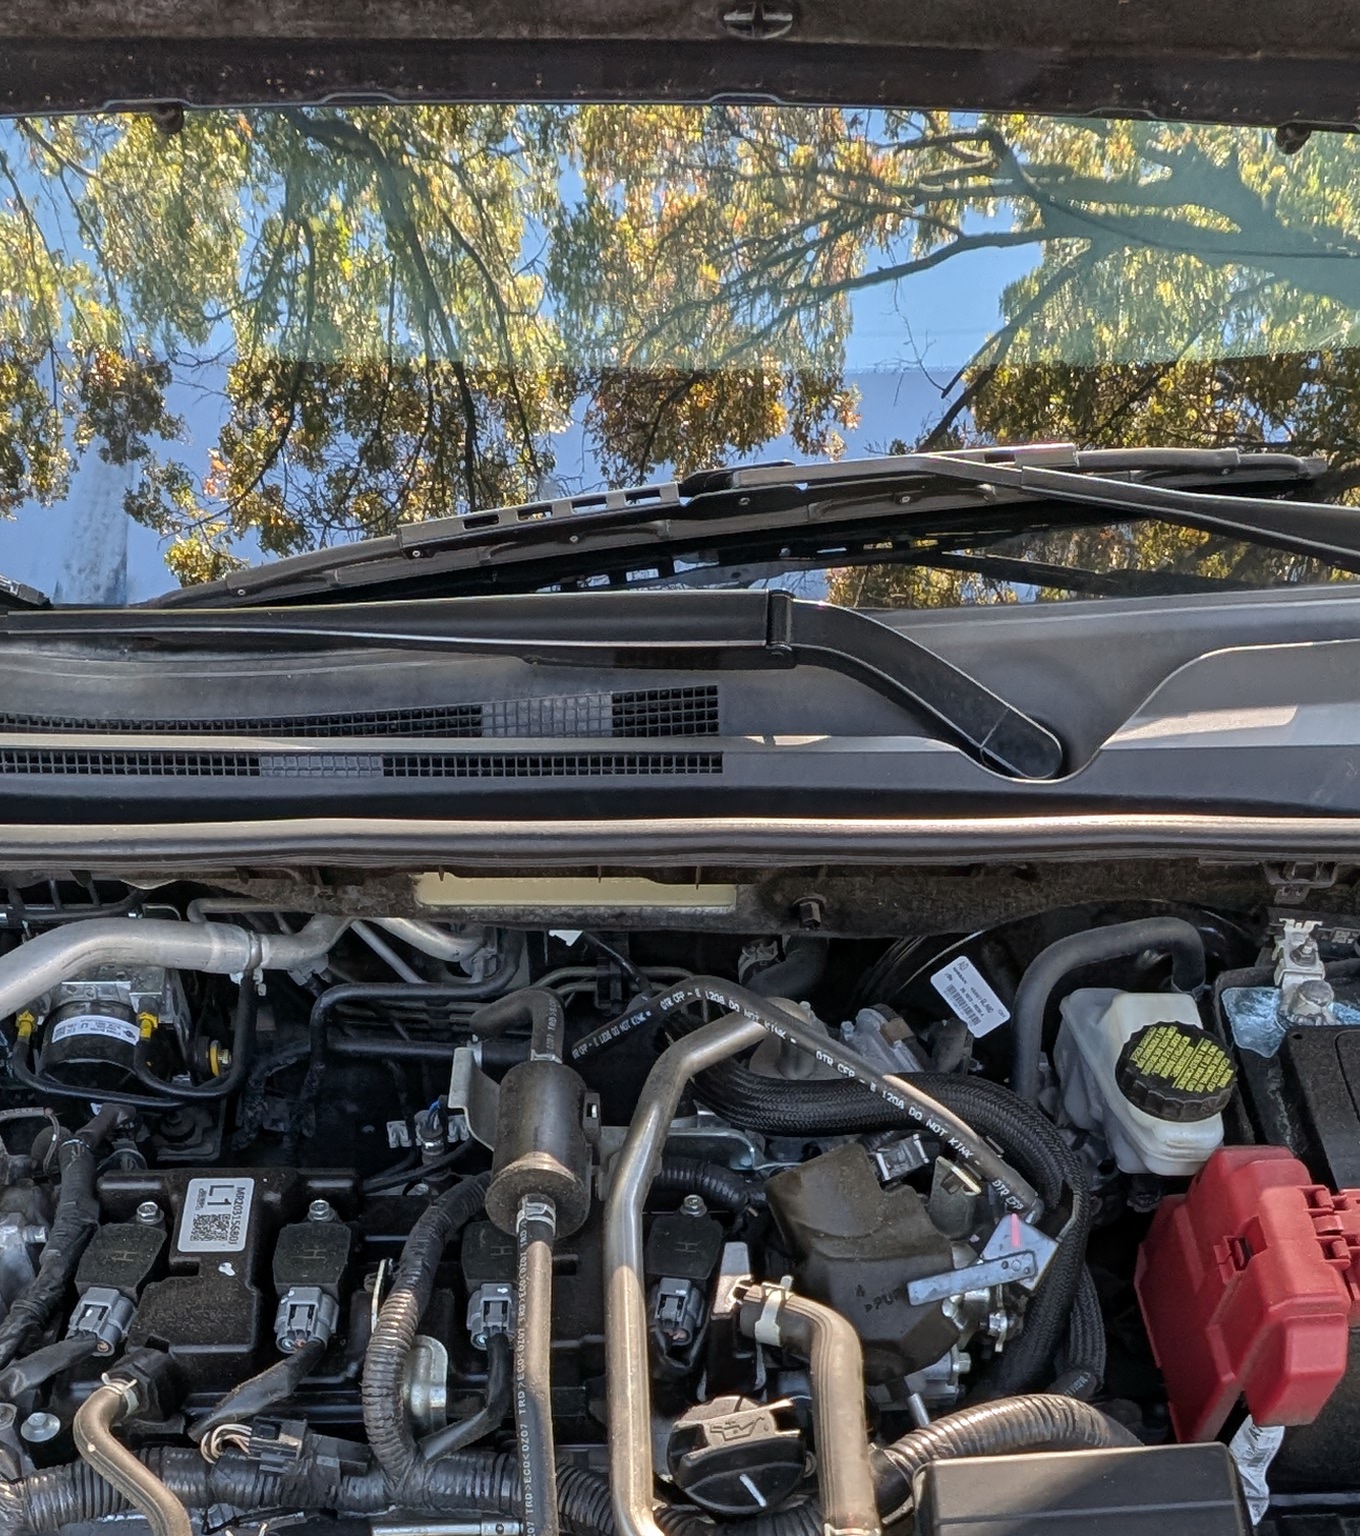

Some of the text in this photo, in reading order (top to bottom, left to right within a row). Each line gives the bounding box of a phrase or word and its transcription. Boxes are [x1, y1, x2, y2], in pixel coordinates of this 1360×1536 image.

[906, 1105, 925, 1122] DO
[924, 1117, 949, 1139] NOT
[947, 1136, 975, 1161] KINK
[207, 1184, 234, 1205] L1
